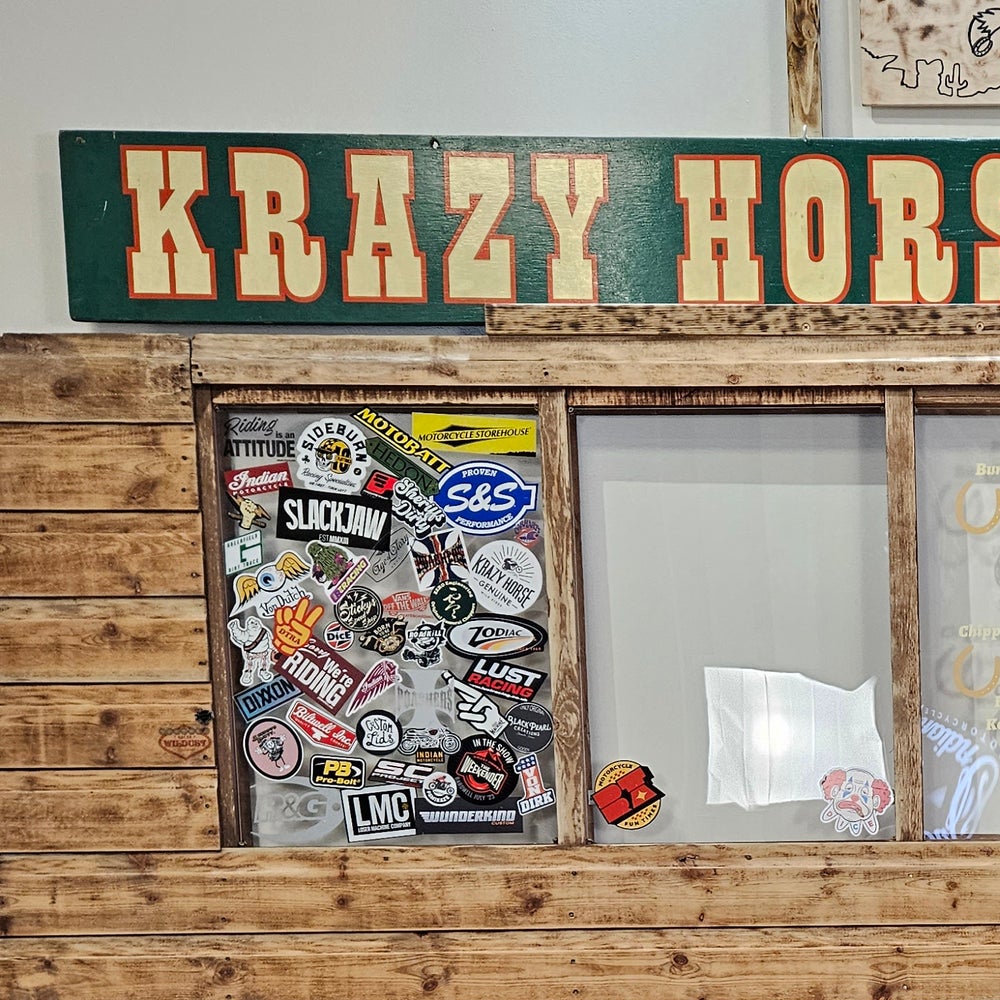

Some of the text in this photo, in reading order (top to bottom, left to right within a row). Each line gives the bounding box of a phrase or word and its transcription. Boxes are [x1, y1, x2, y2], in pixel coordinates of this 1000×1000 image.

[120, 145, 608, 304] KRAZY
[225, 417, 278, 436] Riding
[418, 428, 530, 442] MOTORCYCLE STOREHOUSE
[224, 439, 296, 457] ATTITUDE
[302, 423, 367, 462] SIDEBURN
[357, 408, 450, 473] MOTOBATT
[371, 442, 432, 490] HEDON
[462, 468, 498, 478] PROVEN
[228, 470, 288, 490] Indian
[233, 482, 289, 495] MOTORCYCLE
[444, 482, 518, 512] S&S
[283, 498, 387, 541] SLACKJAW
[455, 513, 514, 528] PERFORMANCE
[472, 554, 506, 585] KRAZY
[501, 577, 536, 608] HORSE
[276, 586, 306, 607] Dutch
[479, 580, 512, 607] GENUINE
[279, 628, 301, 645] DTRA
[469, 625, 523, 647] ZODIAC
[281, 652, 347, 709] RIDING
[322, 657, 354, 688] We're
[473, 659, 542, 687] LUST
[243, 678, 297, 714] DIXXON
[467, 673, 534, 698] RACING
[472, 739, 481, 747] IN
[483, 738, 497, 749] THE
[495, 743, 515, 764] SHOW
[315, 775, 358, 786] Pro-Bolt
[323, 760, 351, 777] PB
[374, 760, 433, 779] SC
[460, 755, 505, 791] WEEKENDER
[598, 763, 633, 787] MOTORCYCLE
[353, 792, 410, 827] LMC
[520, 791, 554, 813] DIRK
[641, 804, 657, 823] TIMES
[419, 809, 516, 822] WUNDERKIND
